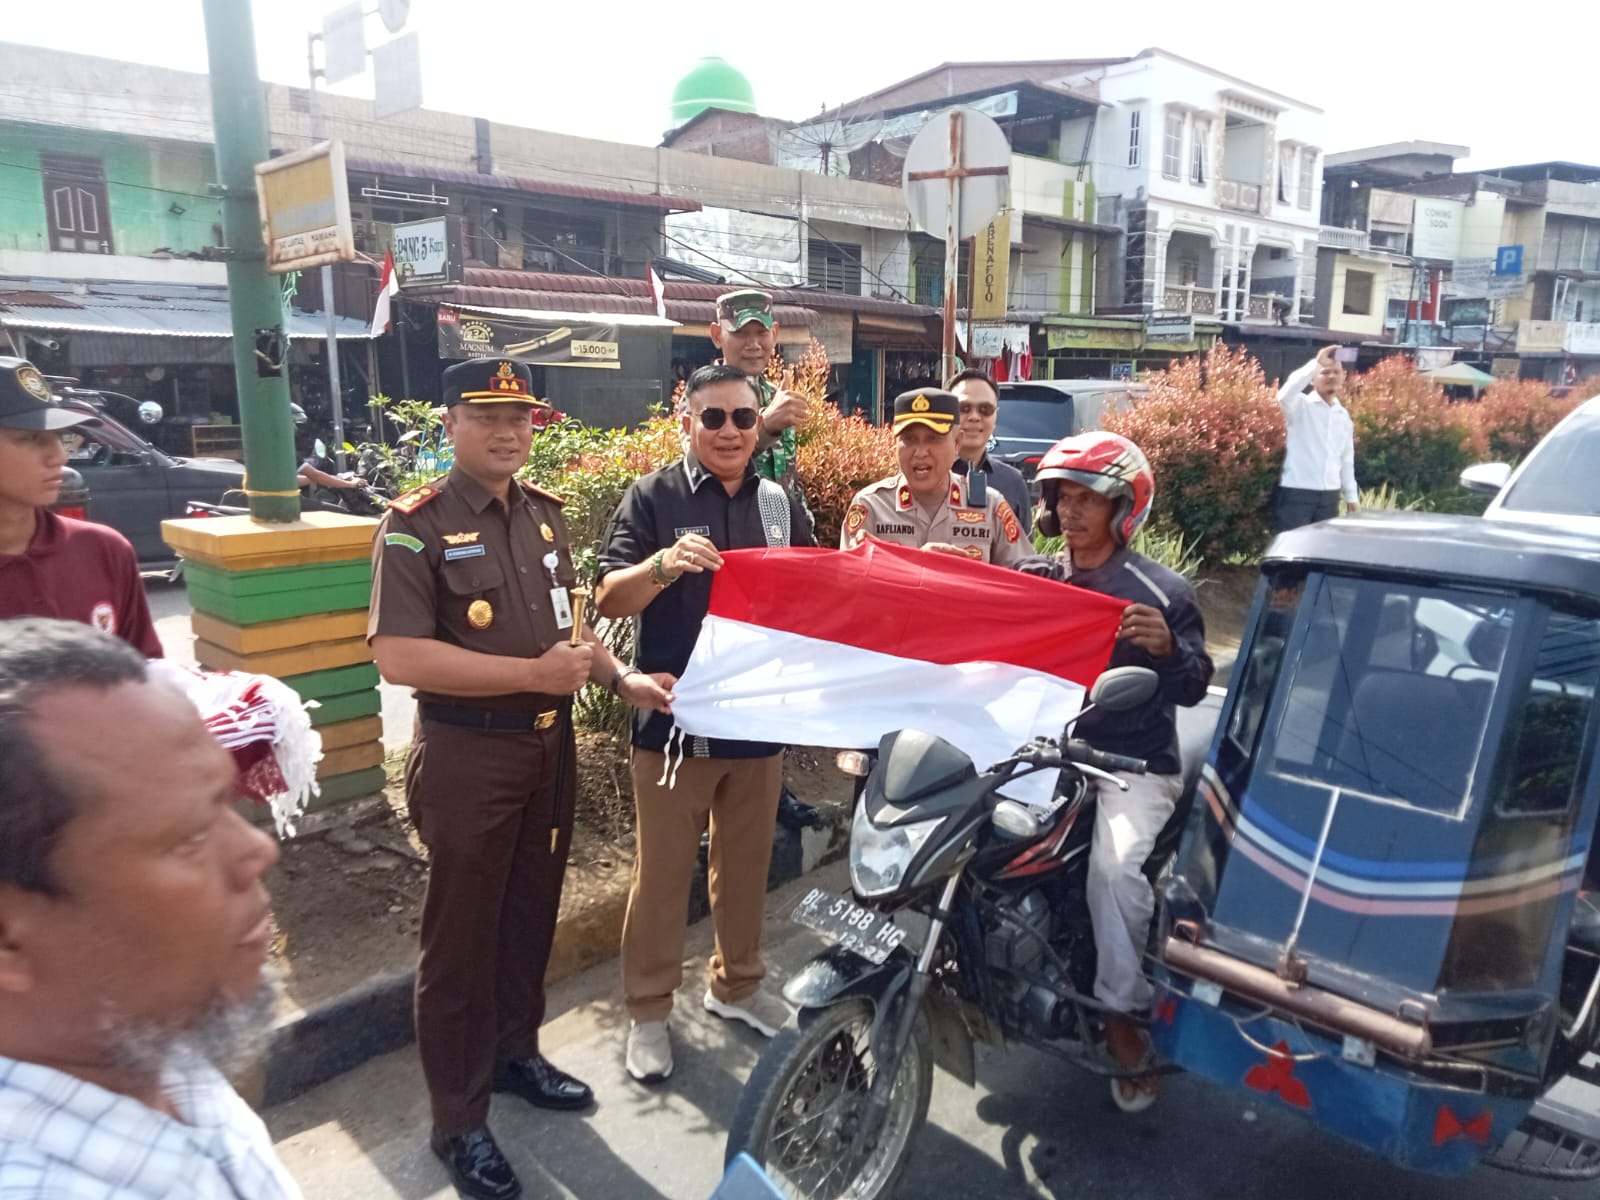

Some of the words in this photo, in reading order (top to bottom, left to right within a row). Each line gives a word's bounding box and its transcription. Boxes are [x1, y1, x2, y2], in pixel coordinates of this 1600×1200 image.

[421, 236, 428, 261] 5
[1502, 250, 1517, 270] P
[466, 329, 487, 339] 234
[459, 343, 494, 353] MAGNUM
[952, 526, 991, 539] POLRI
